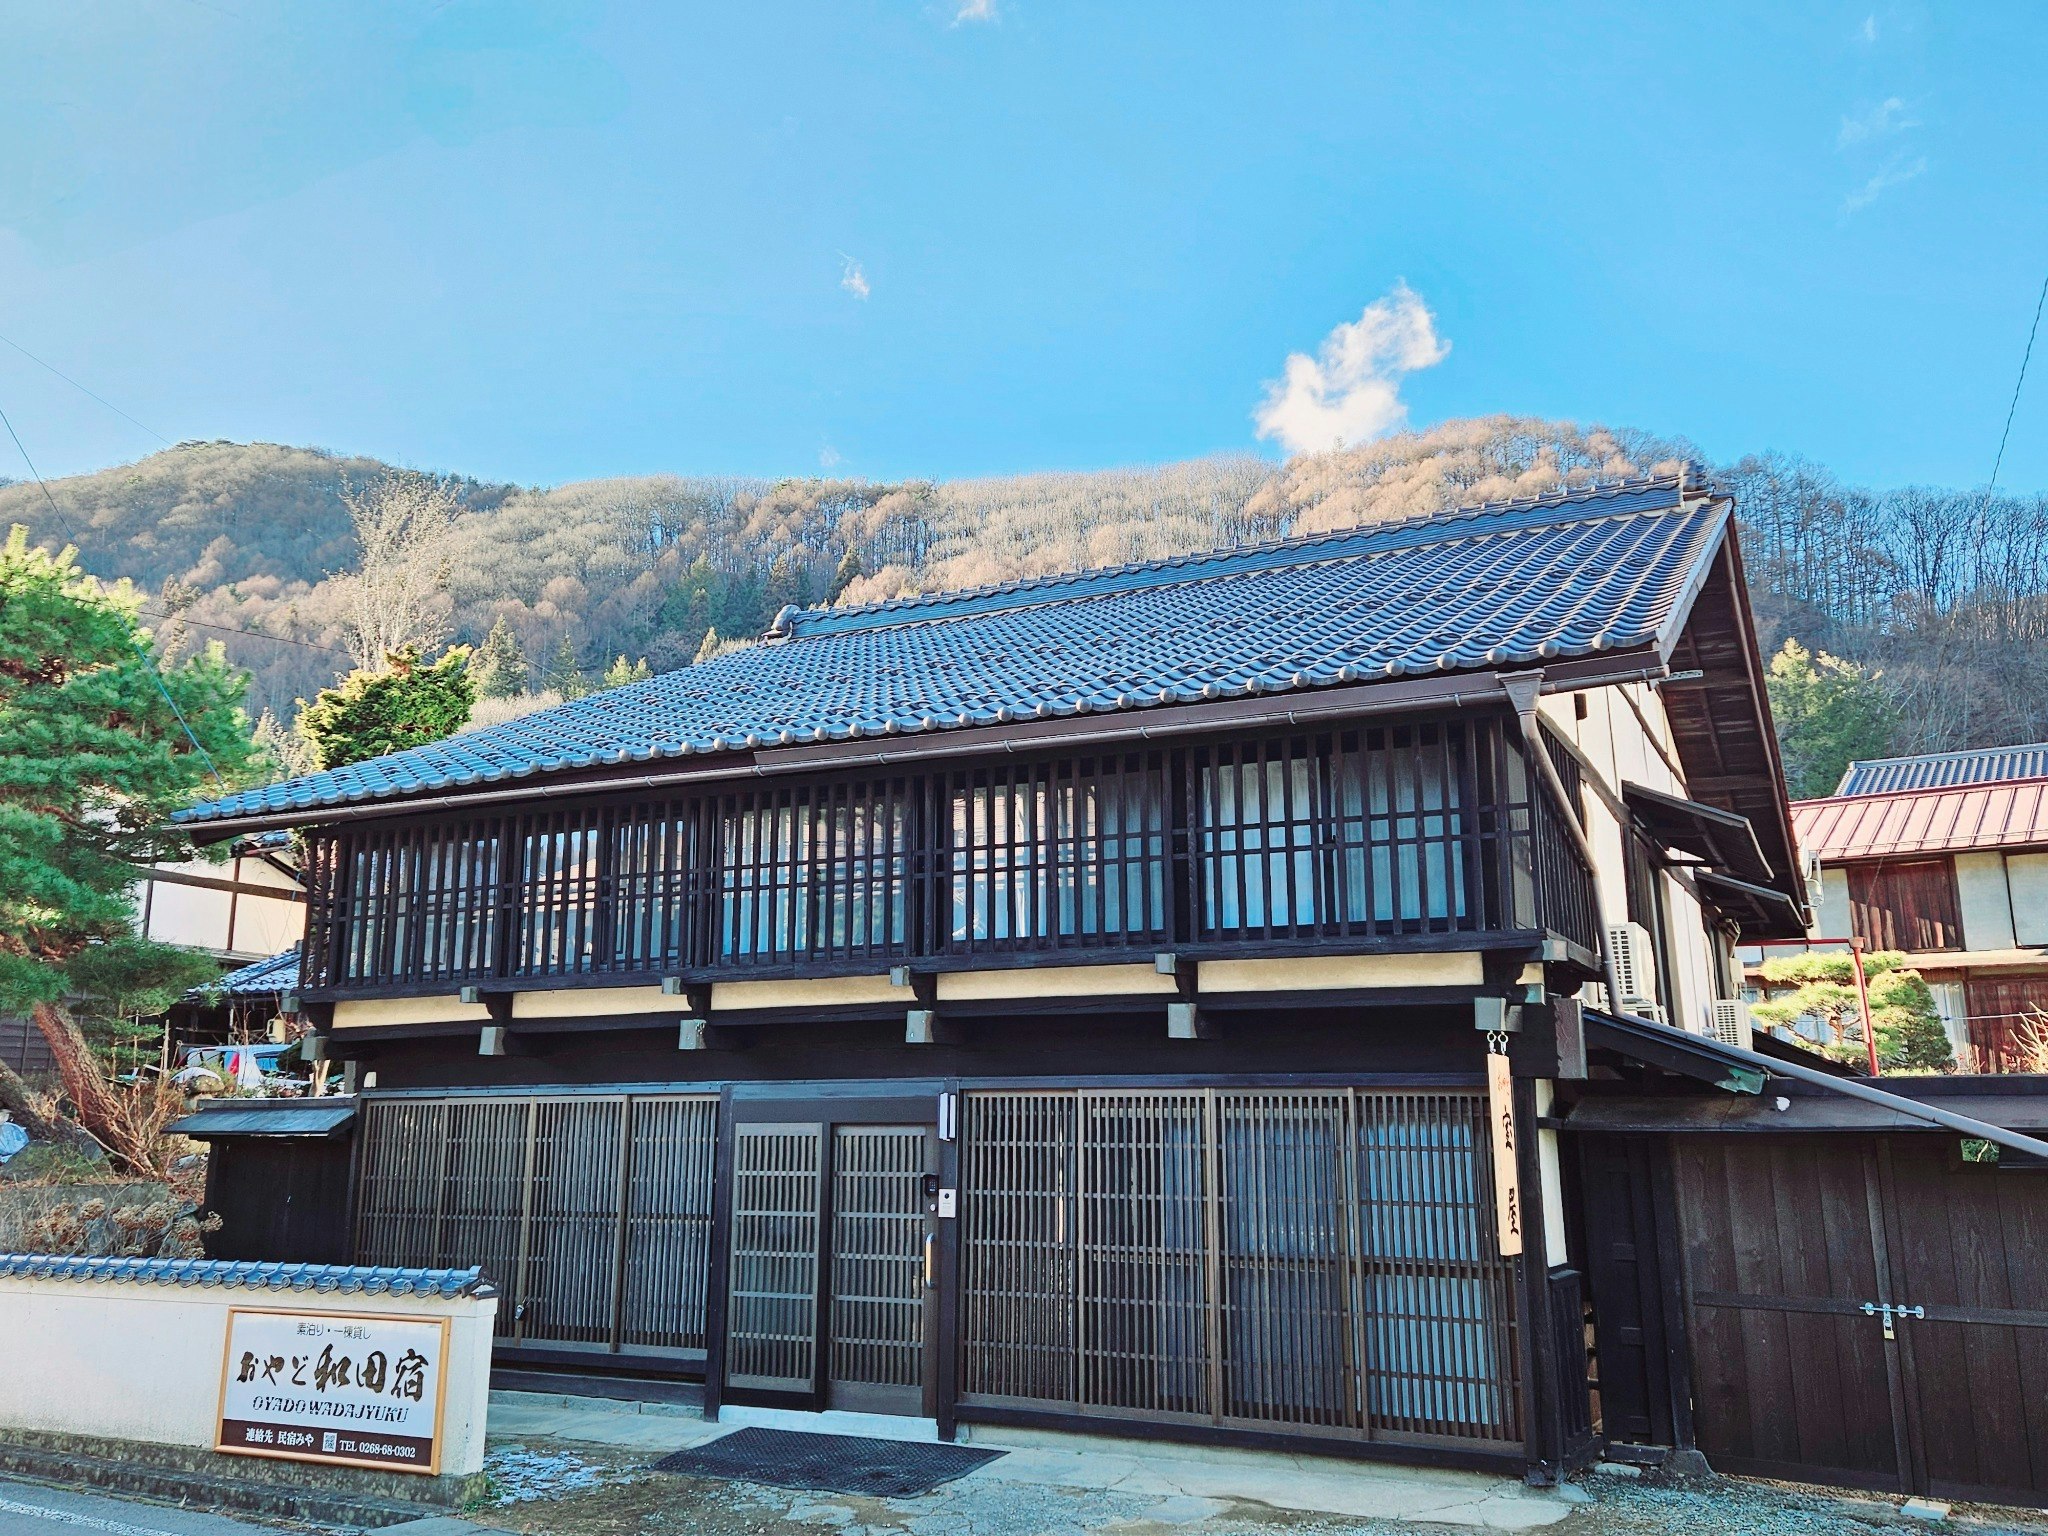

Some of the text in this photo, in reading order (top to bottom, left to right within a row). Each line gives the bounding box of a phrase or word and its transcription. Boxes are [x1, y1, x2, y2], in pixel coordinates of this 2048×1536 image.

[237, 1343, 429, 1402] おやど和田宿
[252, 1396, 409, 1423] OYADO WADAJYUKU
[245, 1427, 416, 1458] 連絡先 民宿みや TEL 0268-68-0302
